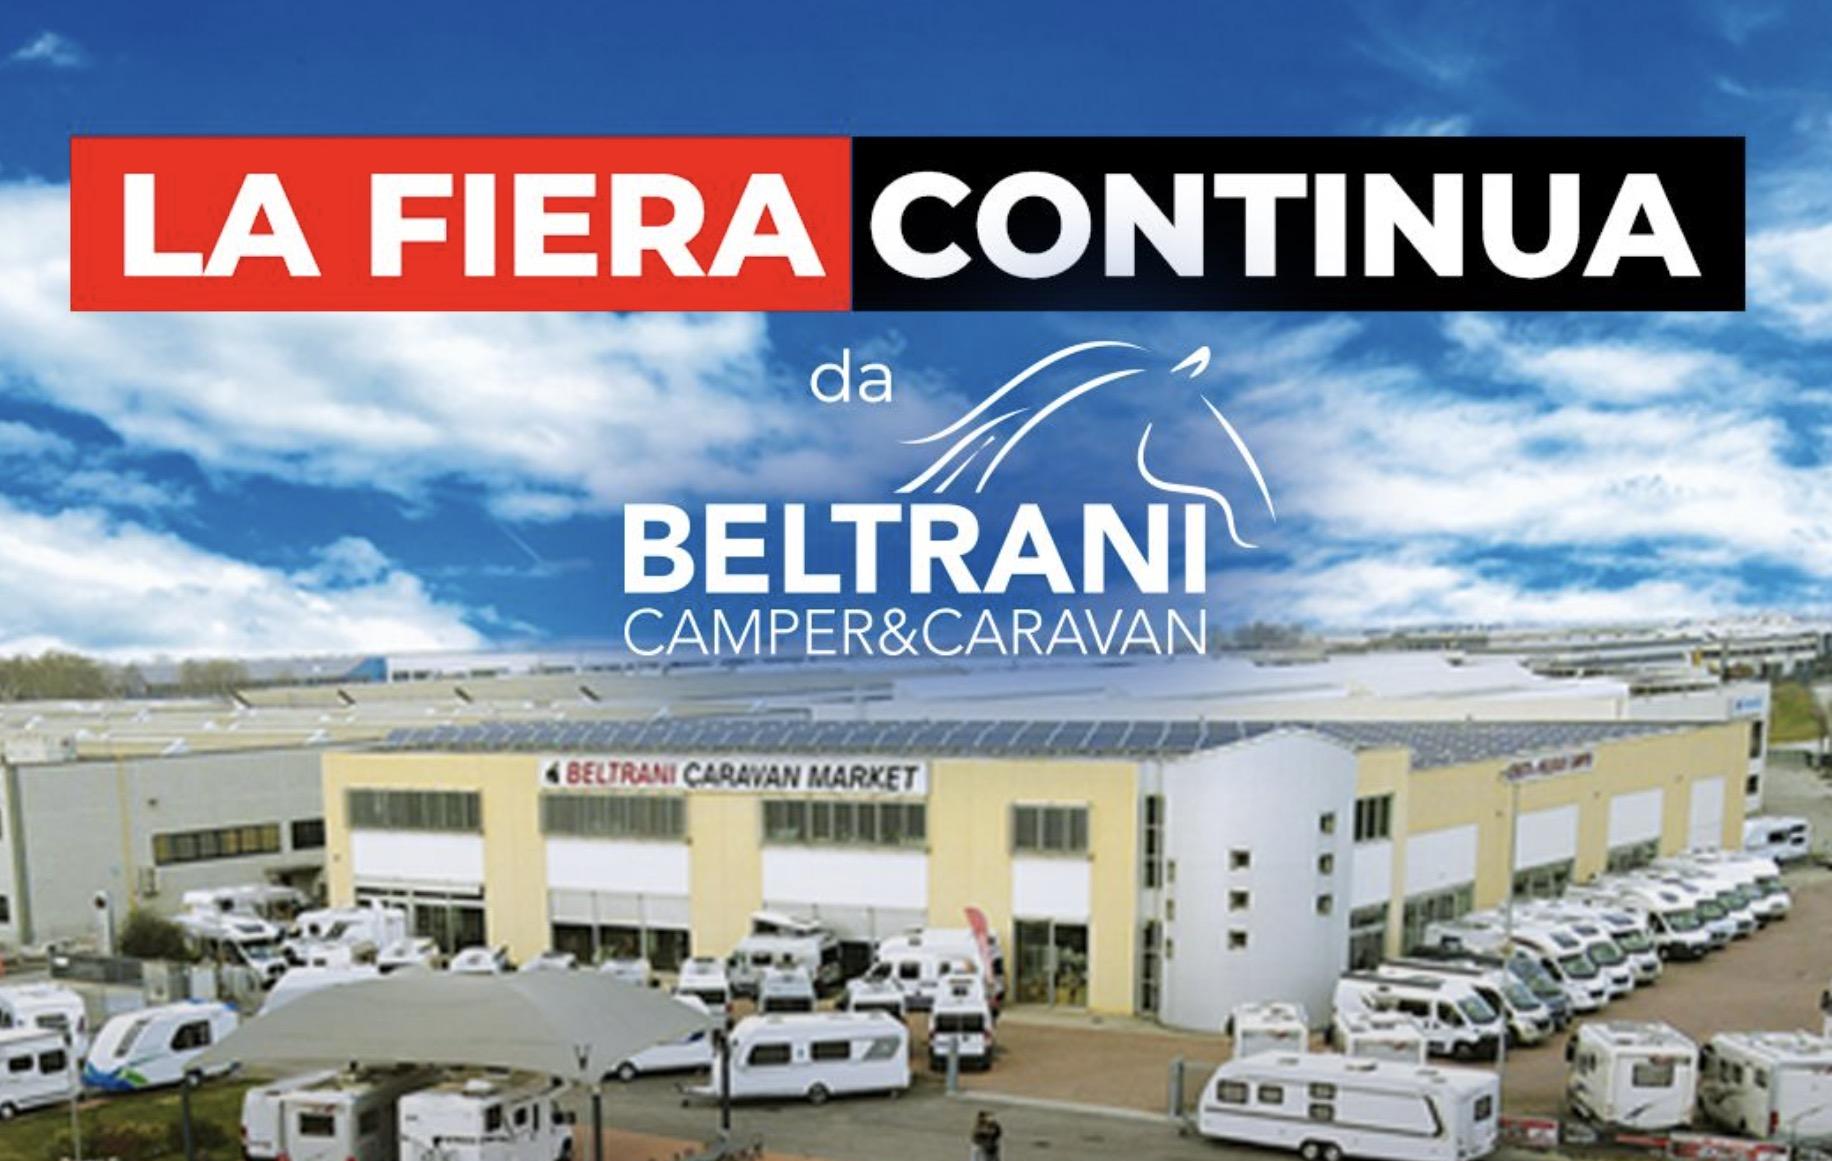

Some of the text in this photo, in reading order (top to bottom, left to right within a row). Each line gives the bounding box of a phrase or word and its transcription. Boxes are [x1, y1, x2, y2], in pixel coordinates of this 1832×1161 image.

[565, 761, 920, 791] BELTRANI CARAVAN MARKET
